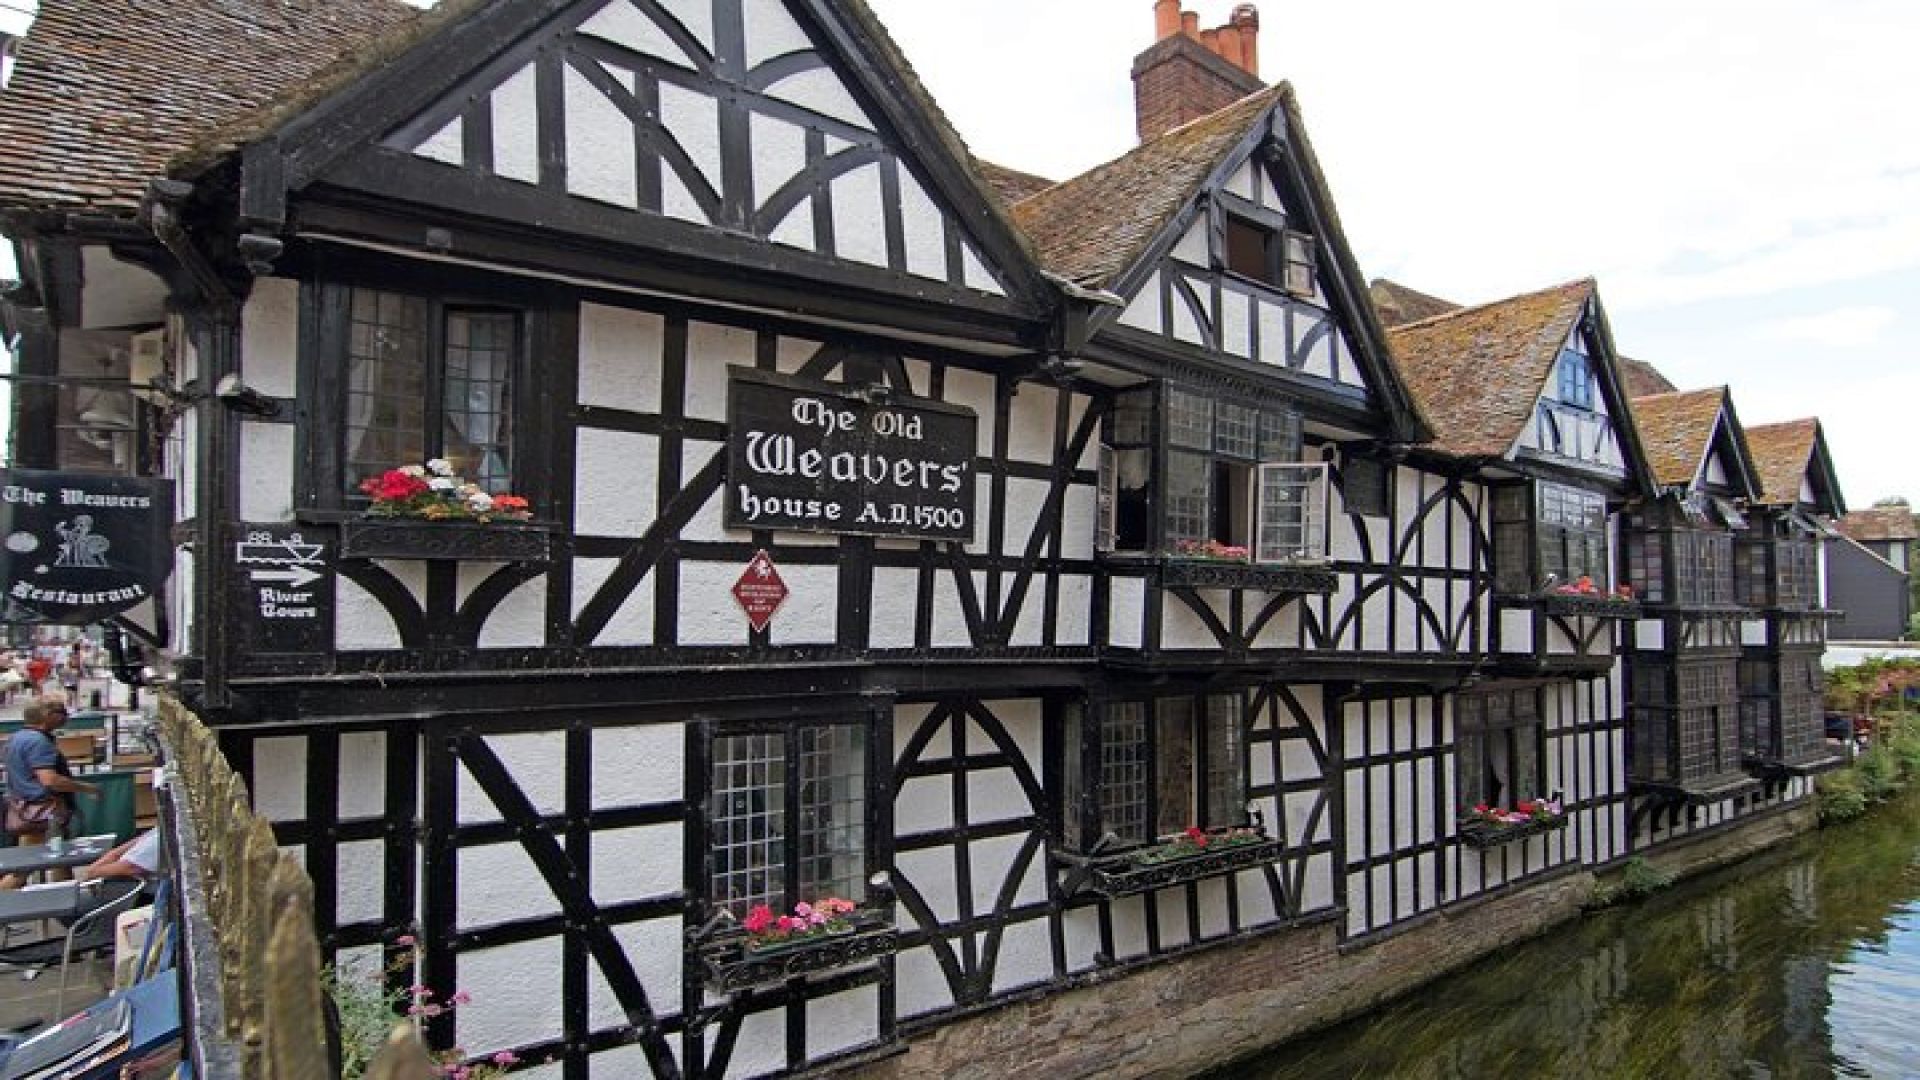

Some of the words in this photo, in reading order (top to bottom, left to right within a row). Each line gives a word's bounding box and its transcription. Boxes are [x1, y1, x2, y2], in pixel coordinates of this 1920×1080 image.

[792, 398, 856, 437] The
[872, 410, 923, 440] Old
[2, 485, 46, 507] The
[61, 488, 150, 507] Weavers
[10, 580, 145, 604] Restaurant
[260, 587, 313, 603] River
